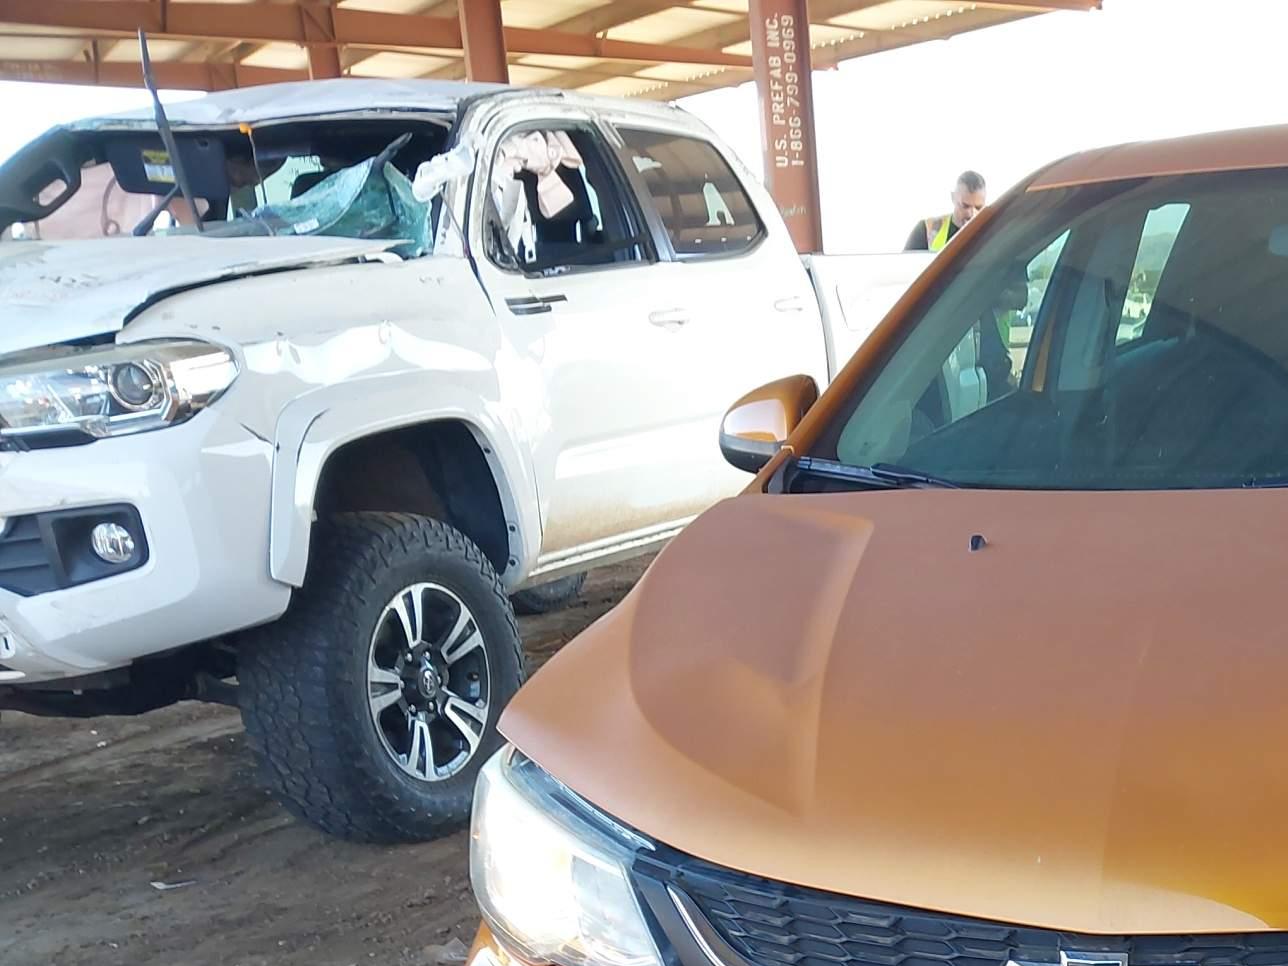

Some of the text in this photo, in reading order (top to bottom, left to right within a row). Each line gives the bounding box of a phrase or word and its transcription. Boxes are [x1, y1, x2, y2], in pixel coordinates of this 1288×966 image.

[765, 12, 788, 168] U.S. PREFAB INC.
[780, 15, 804, 166] 1-866-799-0969
